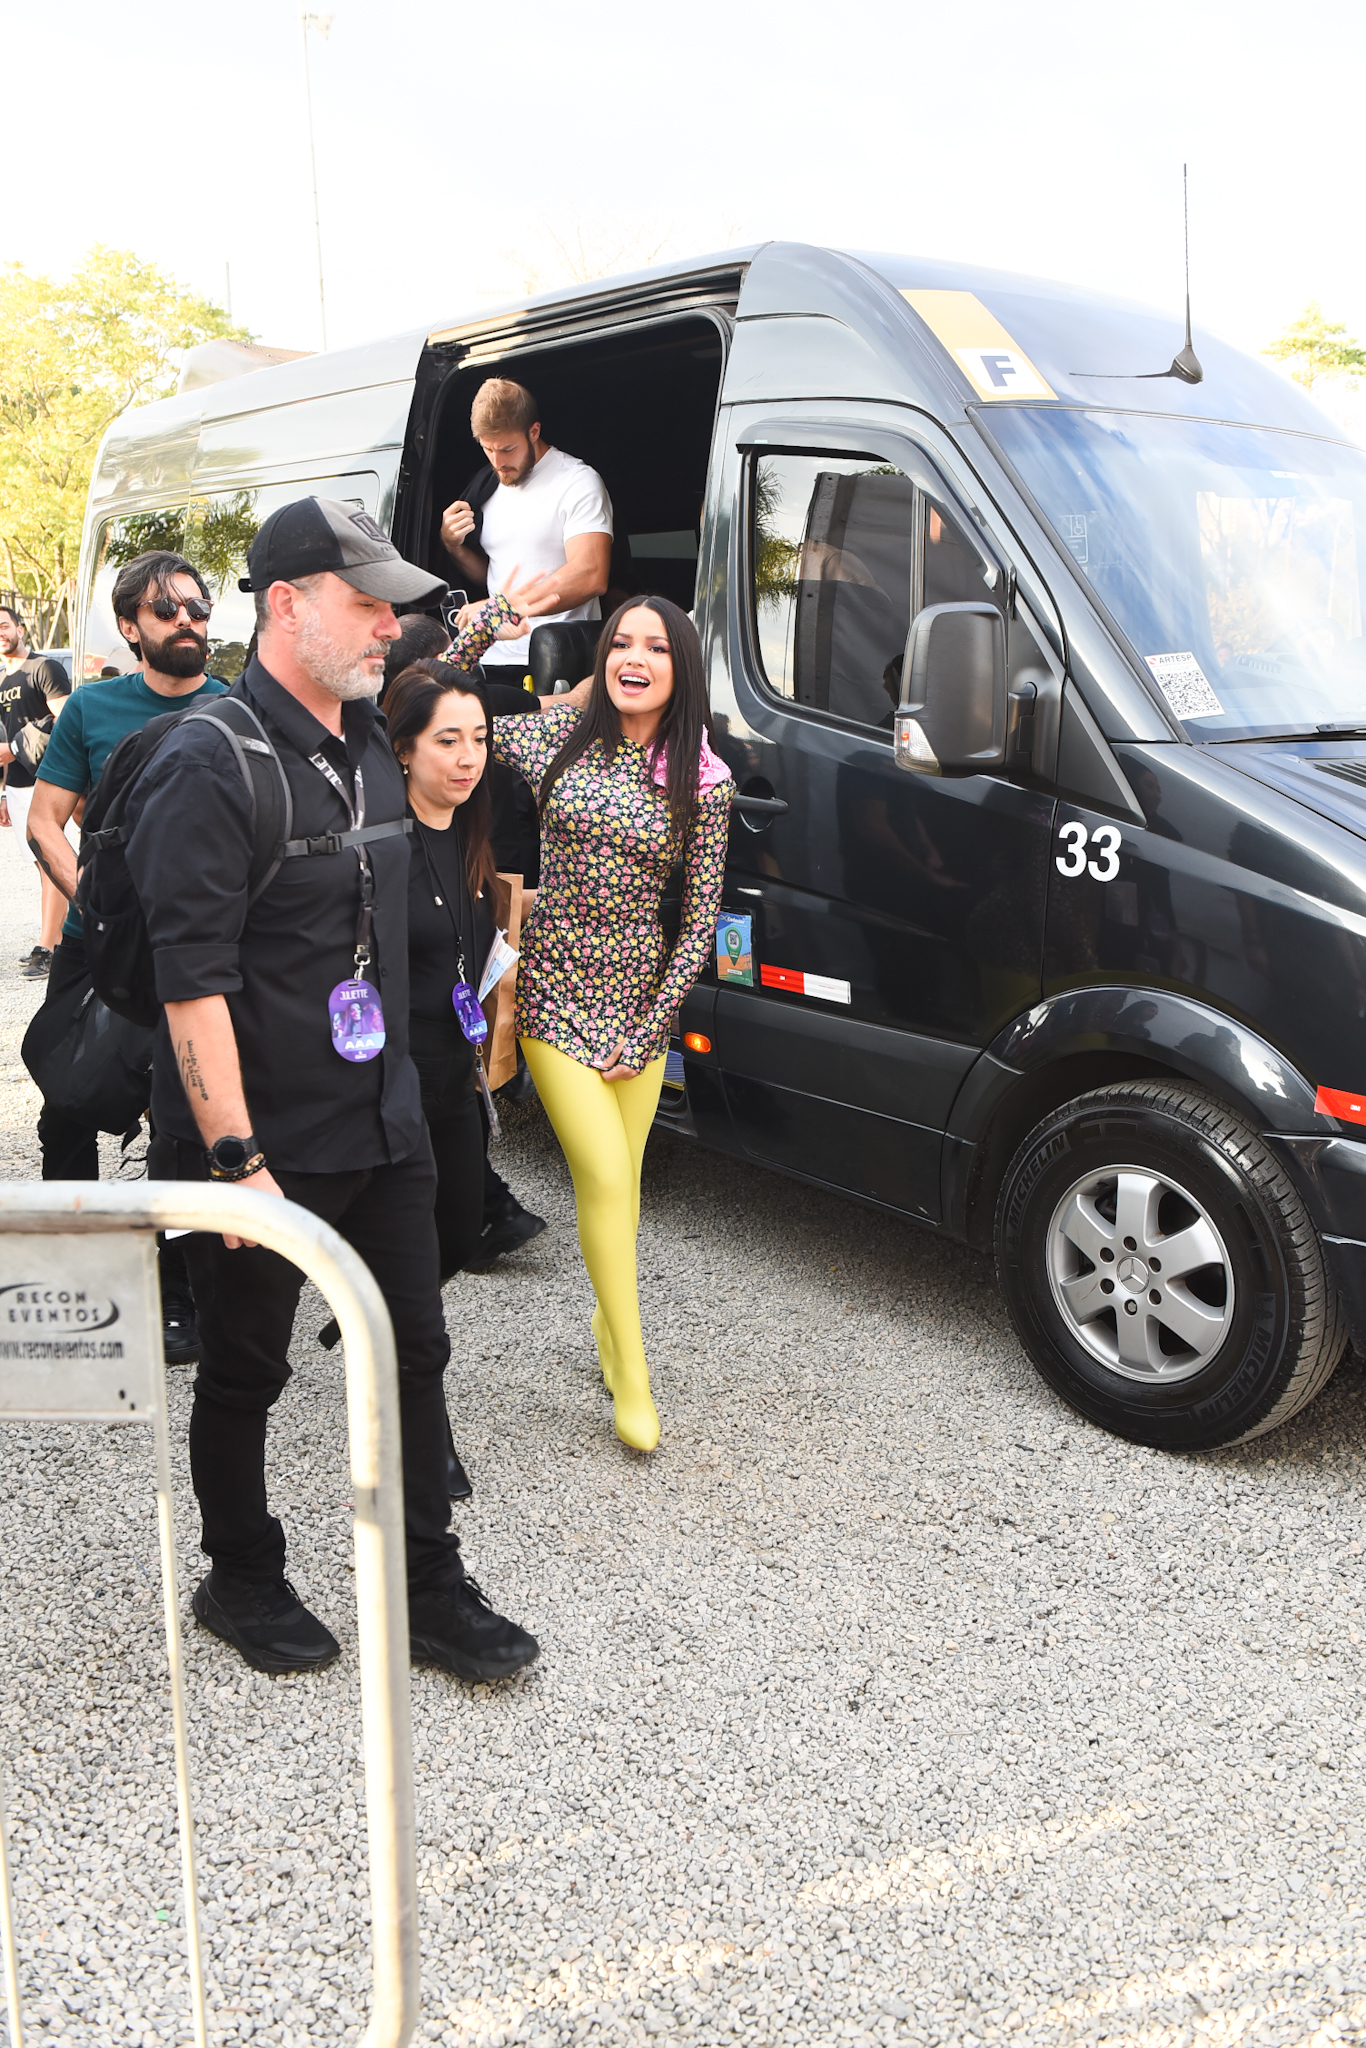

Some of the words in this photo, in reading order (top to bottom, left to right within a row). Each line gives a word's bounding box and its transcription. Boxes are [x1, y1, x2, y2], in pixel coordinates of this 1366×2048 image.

[979, 355, 1017, 387] F
[1159, 653, 1192, 664] ARTESP
[0, 685, 21, 704] UCCI
[1055, 821, 1122, 883] 33
[469, 1027, 484, 1036] AAA
[344, 1038, 375, 1050] AAA
[1007, 1133, 1066, 1230] MICHELIN
[16, 1291, 87, 1304] RECON
[8, 1308, 100, 1323] EVENTOS
[1199, 1324, 1273, 1420] MICHELIN
